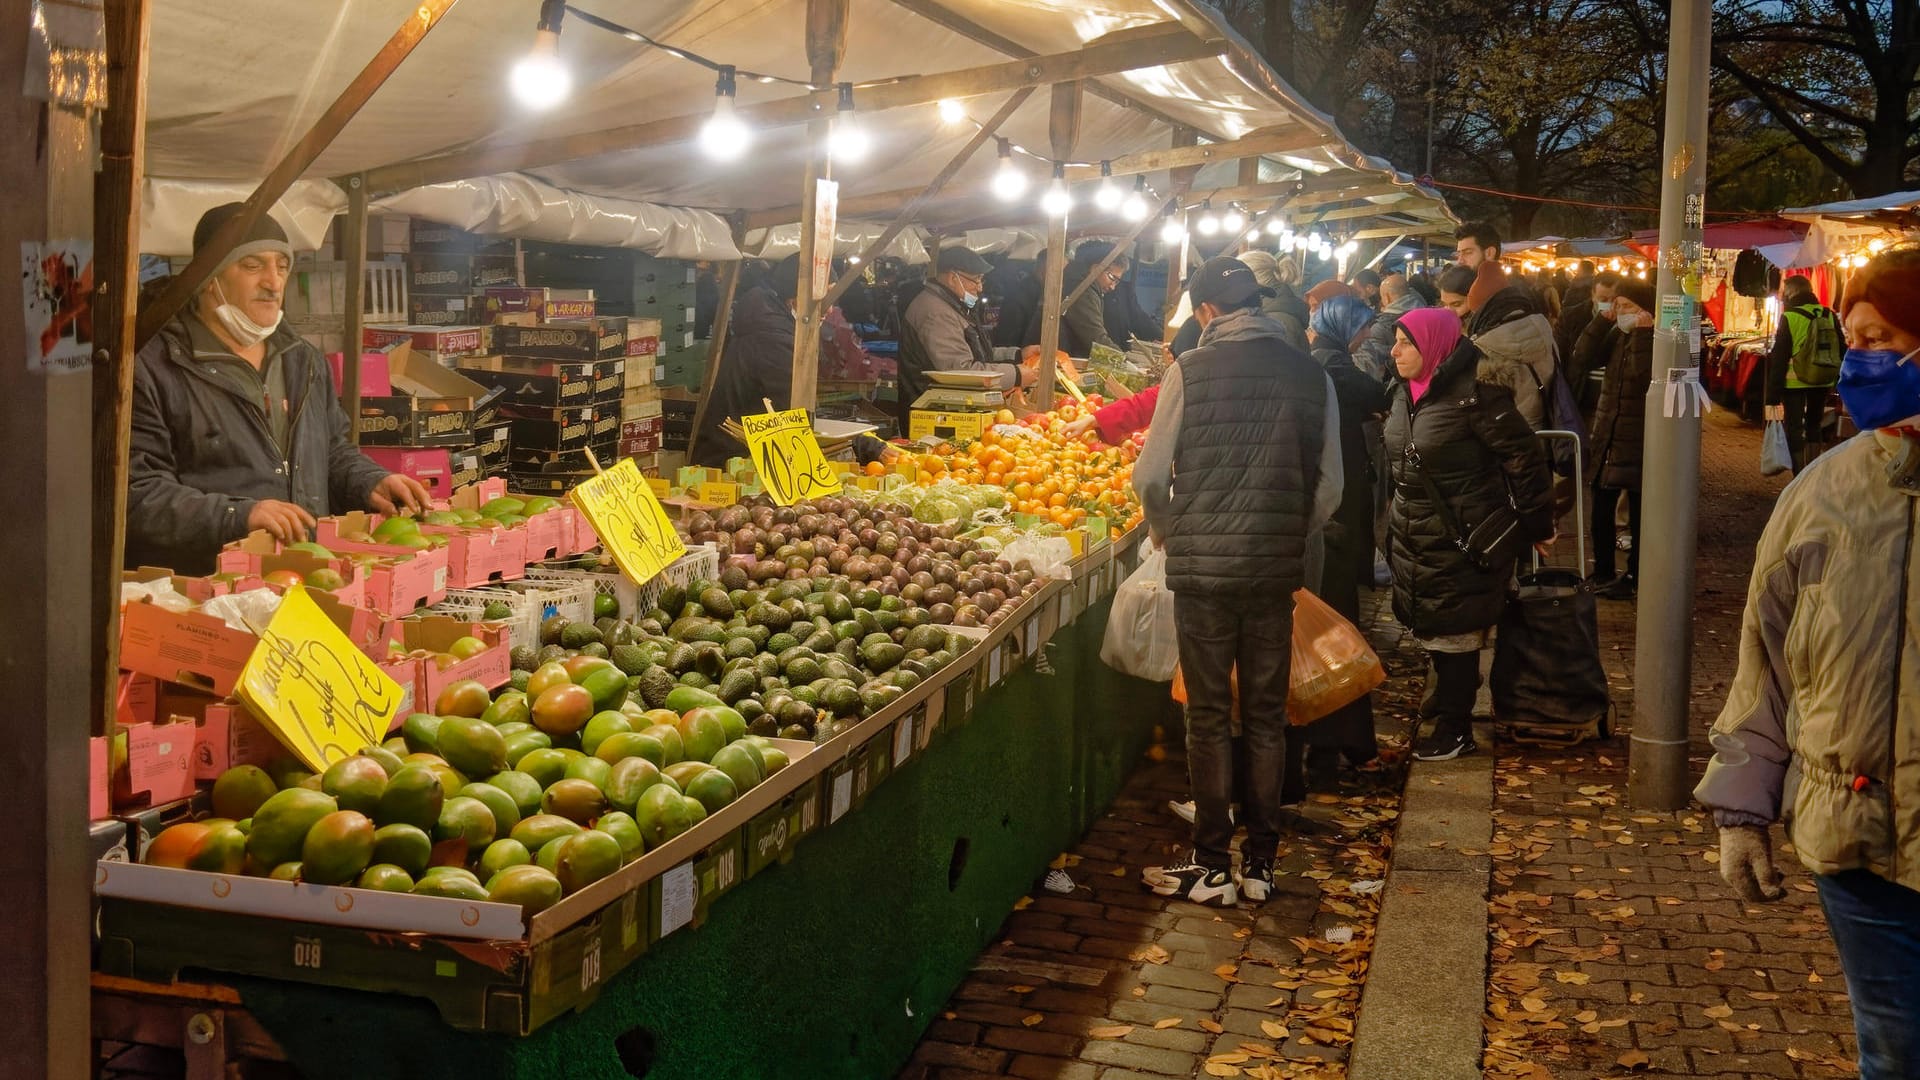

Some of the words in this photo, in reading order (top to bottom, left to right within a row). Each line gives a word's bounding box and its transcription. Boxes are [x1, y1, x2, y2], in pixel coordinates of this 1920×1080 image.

[519, 330, 577, 347] PARDO
[600, 333, 622, 351] PARDO
[562, 381, 588, 397] PARDO
[596, 375, 619, 393] PARDO
[428, 412, 464, 434] PARDO
[562, 423, 587, 441] PARDO
[594, 416, 617, 435] PARDO
[176, 623, 220, 638] FLAMINGO
